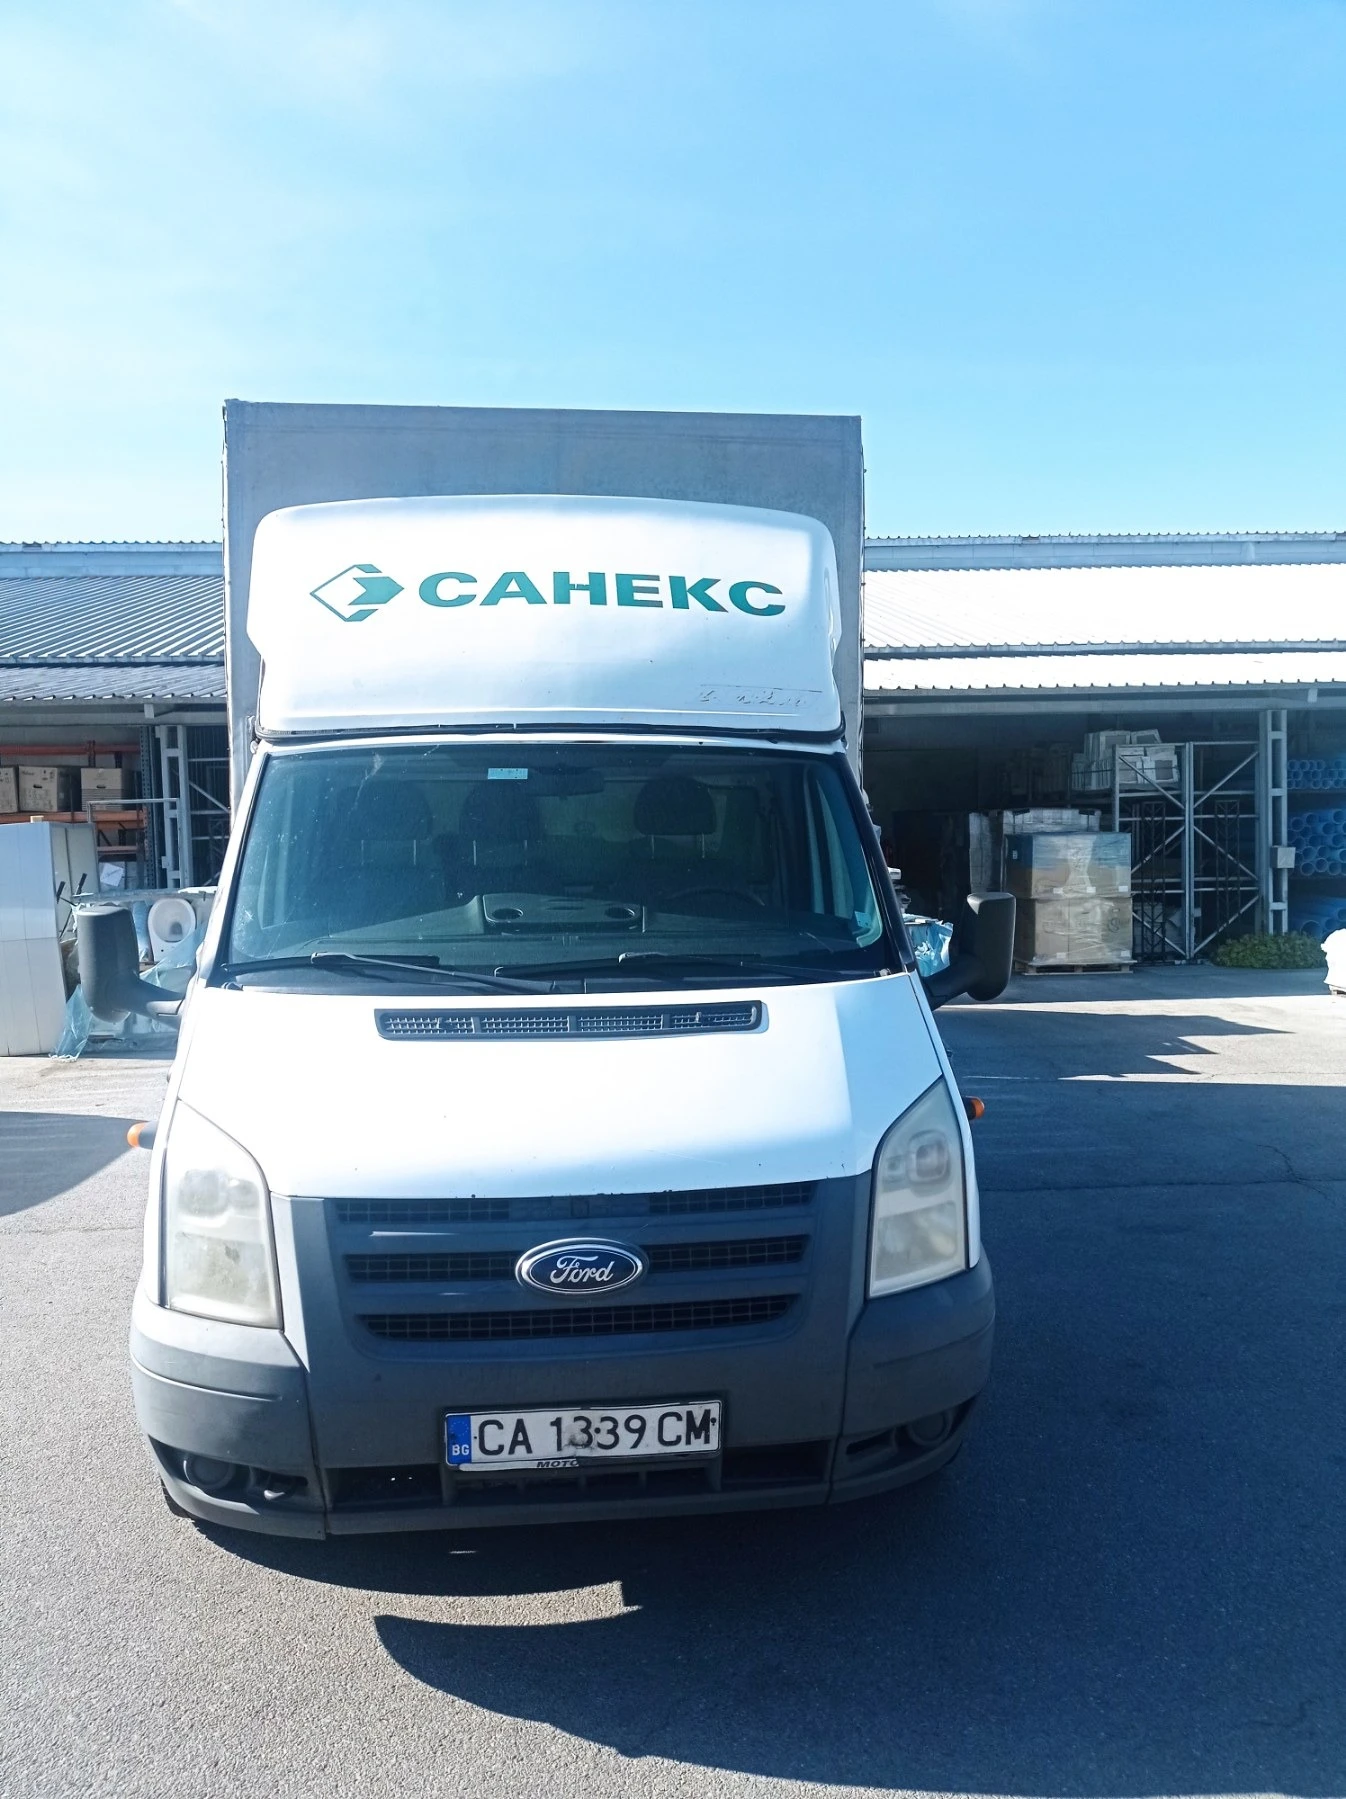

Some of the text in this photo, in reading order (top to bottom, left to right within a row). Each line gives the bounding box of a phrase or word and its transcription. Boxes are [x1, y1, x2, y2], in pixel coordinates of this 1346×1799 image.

[418, 571, 787, 617] САНЕКС
[550, 1255, 615, 1284] Ford
[452, 1444, 470, 1456] BG
[478, 1409, 712, 1456] CA 1339 CM
